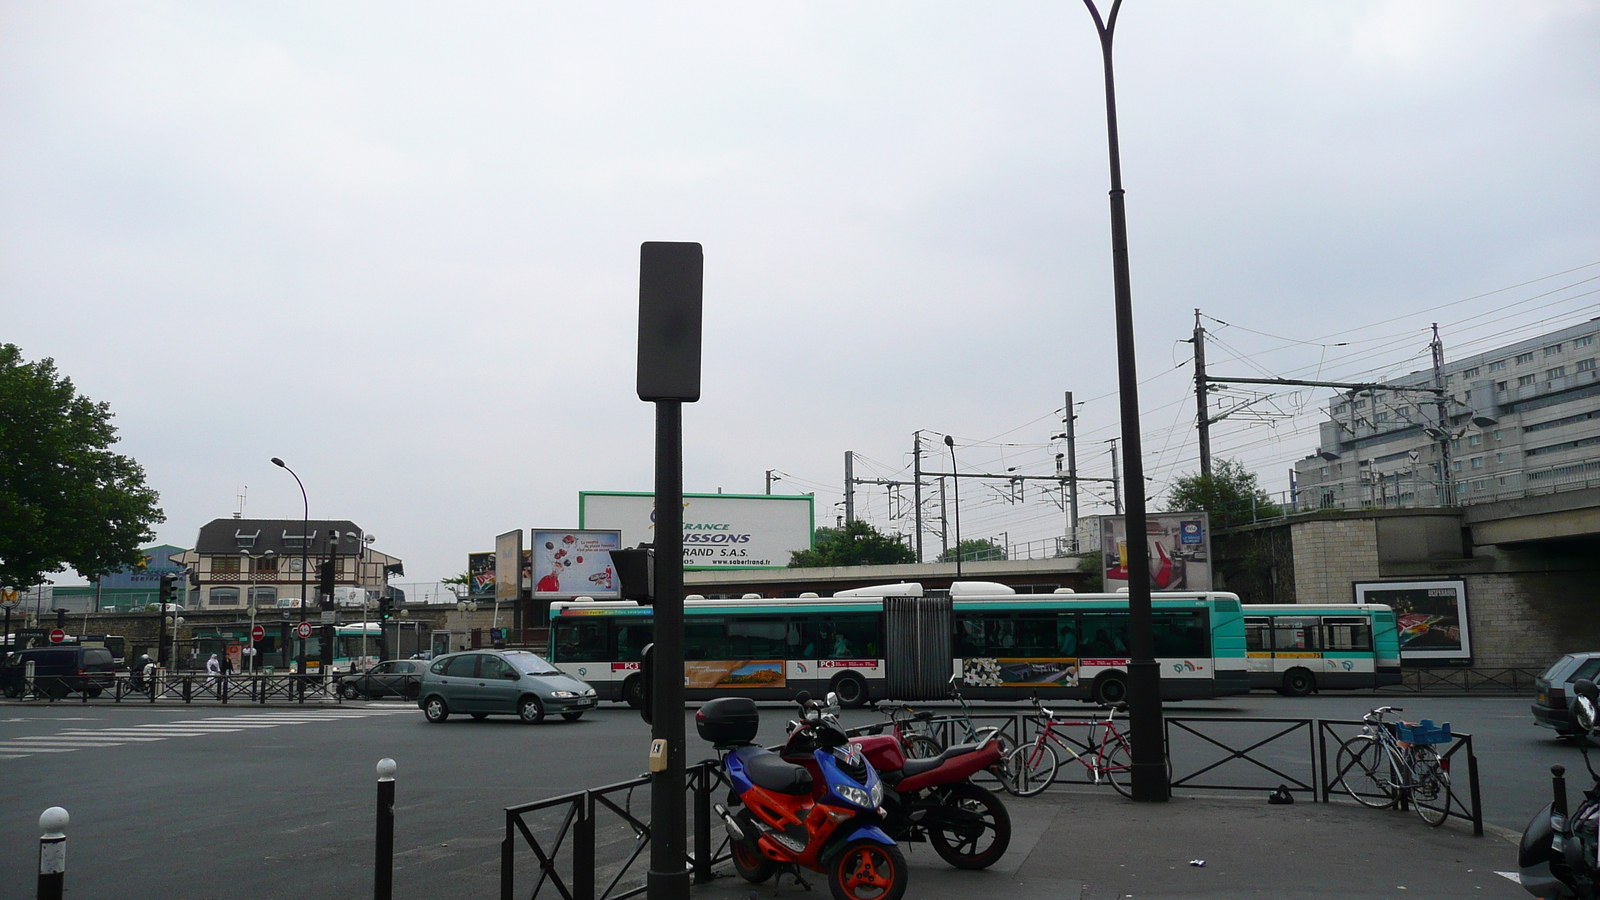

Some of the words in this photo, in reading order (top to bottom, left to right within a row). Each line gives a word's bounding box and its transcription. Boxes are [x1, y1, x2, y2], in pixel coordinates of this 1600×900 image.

[683, 533, 751, 543] ISSONS
[683, 548, 714, 556] RAND
[720, 548, 748, 557] S.A.S.
[820, 660, 835, 668] PC3
